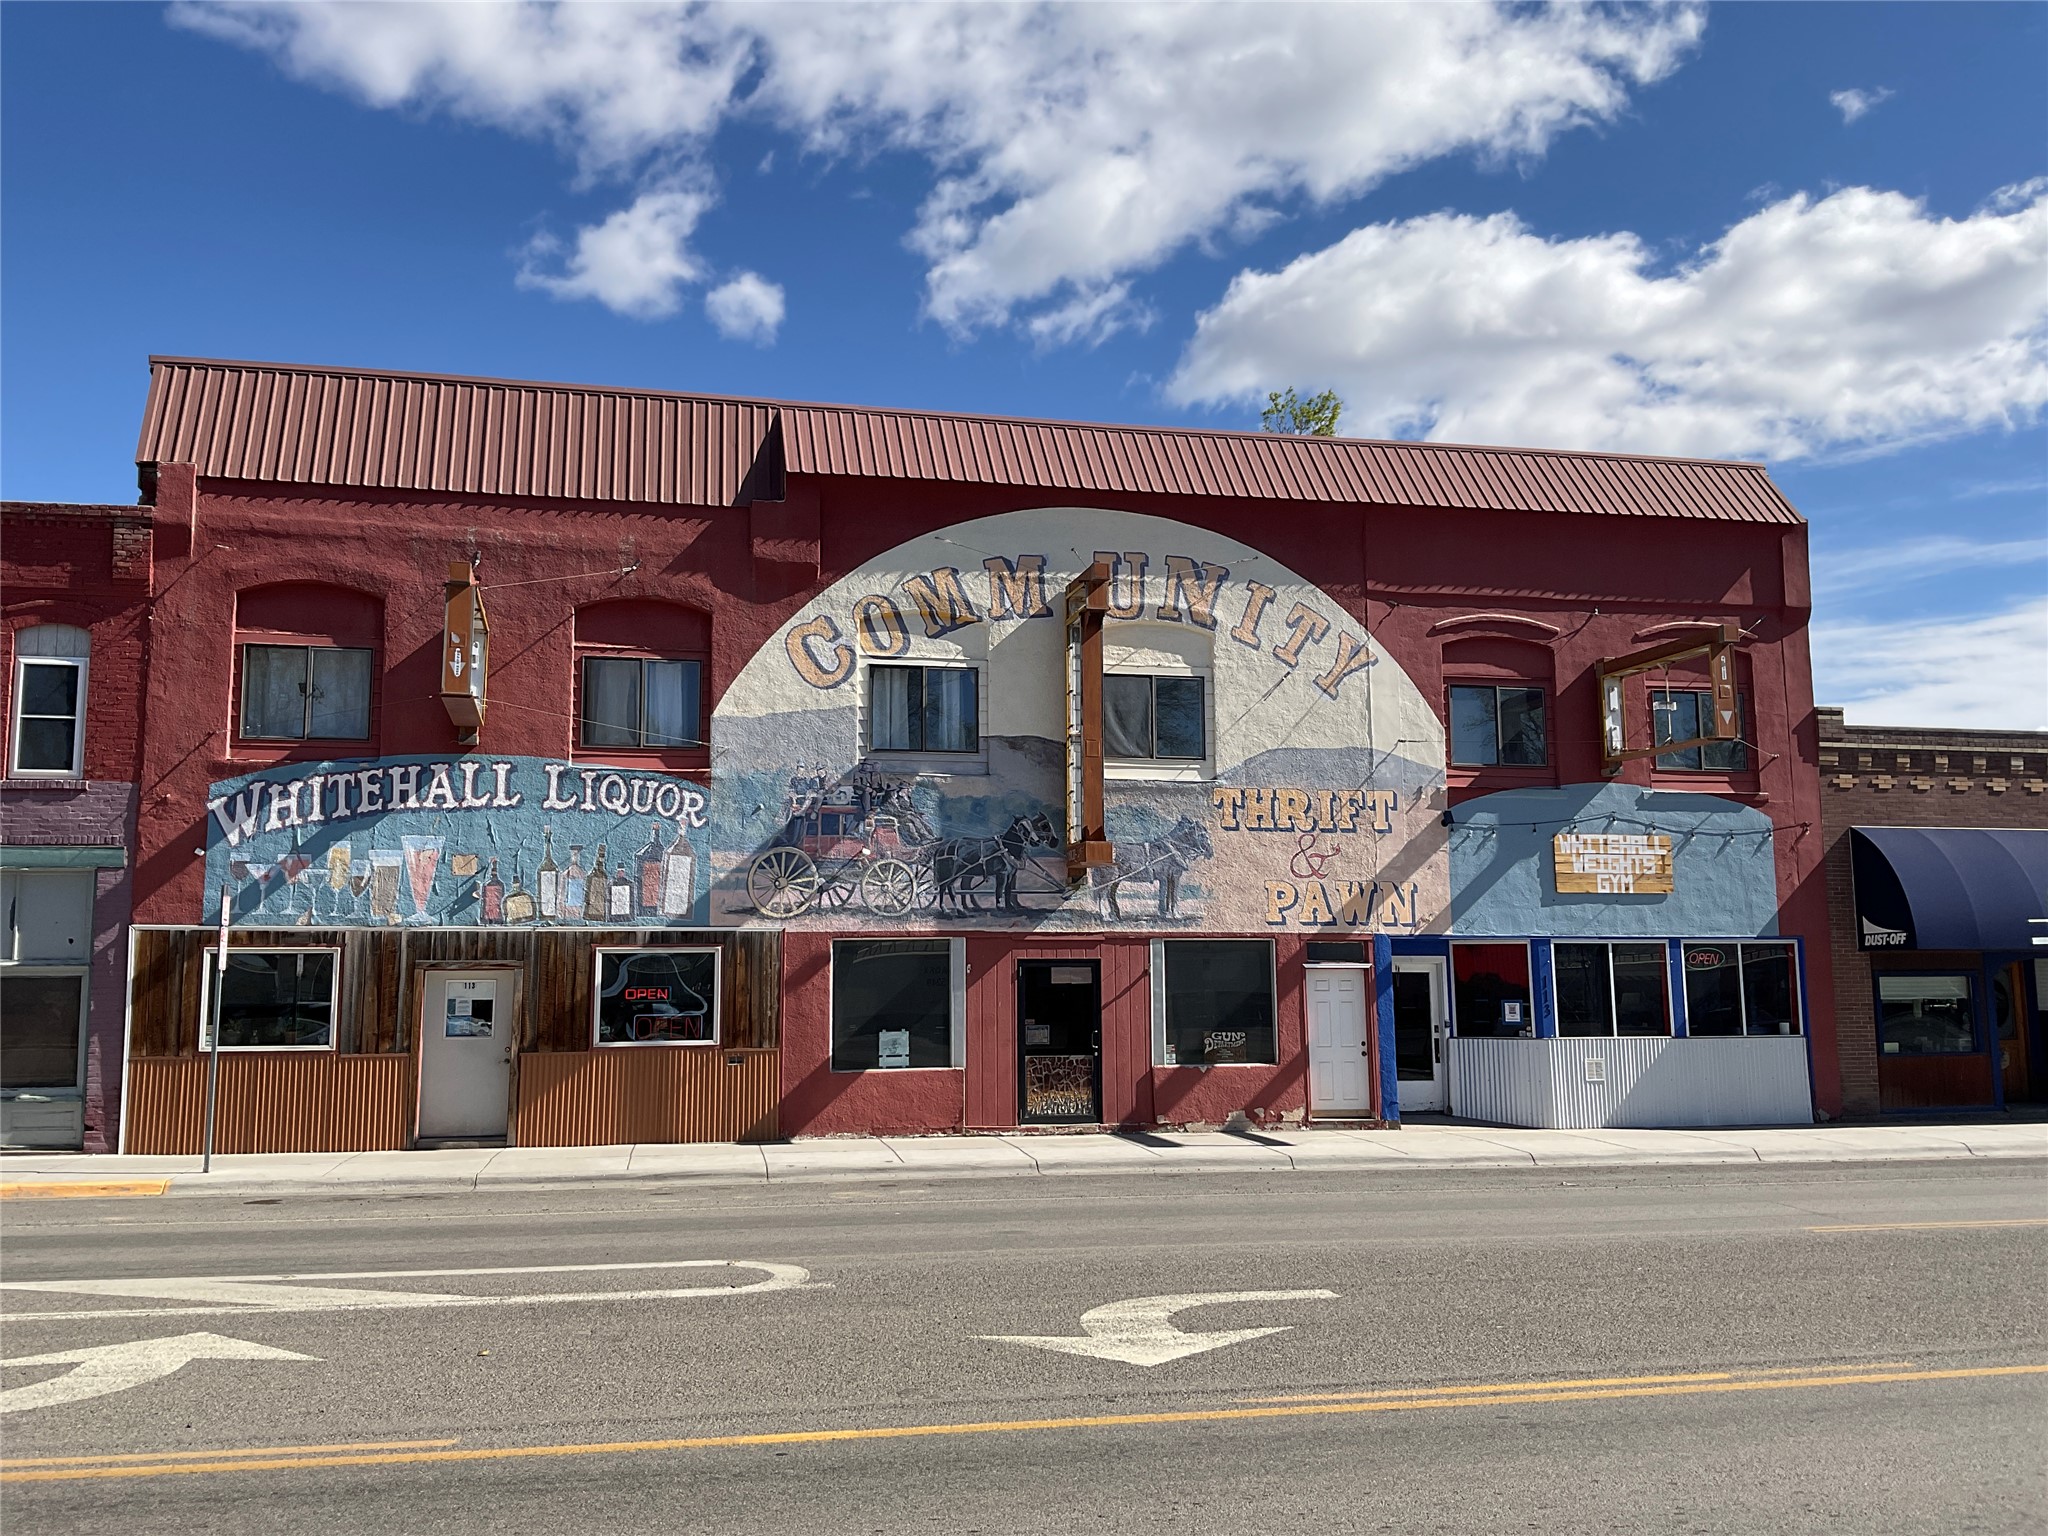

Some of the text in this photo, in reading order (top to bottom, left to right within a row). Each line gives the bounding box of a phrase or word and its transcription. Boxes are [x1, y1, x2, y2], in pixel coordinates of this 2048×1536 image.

[785, 551, 1379, 700] COMMUNITY
[206, 762, 707, 847] WHITEHALL LIQUOR
[1213, 787, 1398, 833] THRIFT
[1290, 834, 1341, 879] &
[1559, 834, 1668, 855] WHITEHALL
[1571, 854, 1656, 875] WEIGHTS
[1597, 874, 1634, 893] GYM
[1264, 880, 1418, 927] PAWN
[1689, 952, 1719, 965] OPEN
[464, 982, 476, 990] 113
[625, 988, 669, 1000] OPEN
[1541, 975, 1551, 1019] 113
[635, 1016, 701, 1040] OPEN
